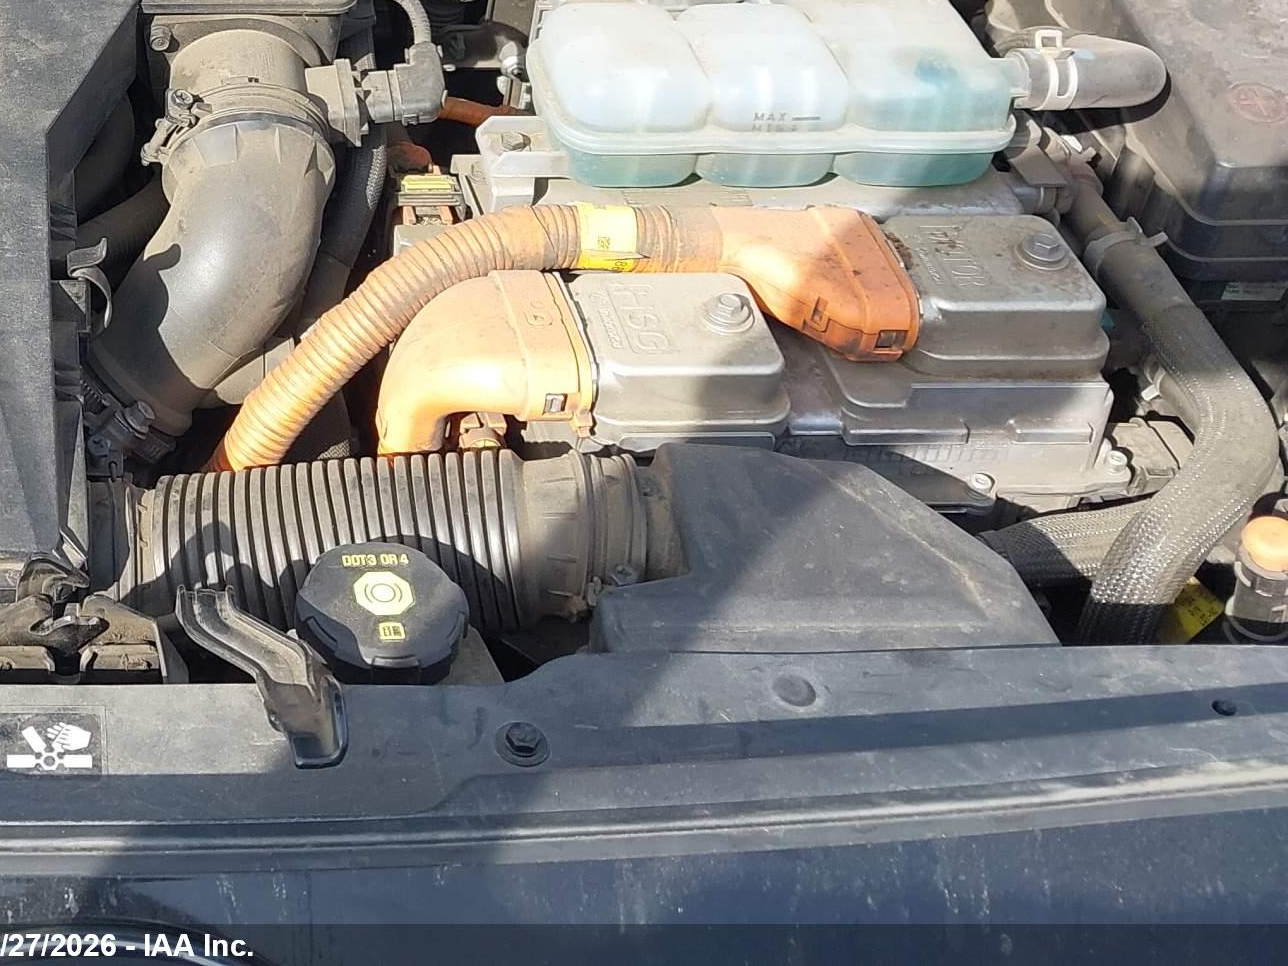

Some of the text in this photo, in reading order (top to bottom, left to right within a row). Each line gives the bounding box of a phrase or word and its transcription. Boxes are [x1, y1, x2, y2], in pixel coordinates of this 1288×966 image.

[752, 112, 788, 122] MAX
[380, 554, 399, 565] OR
[400, 553, 410, 564] 4
